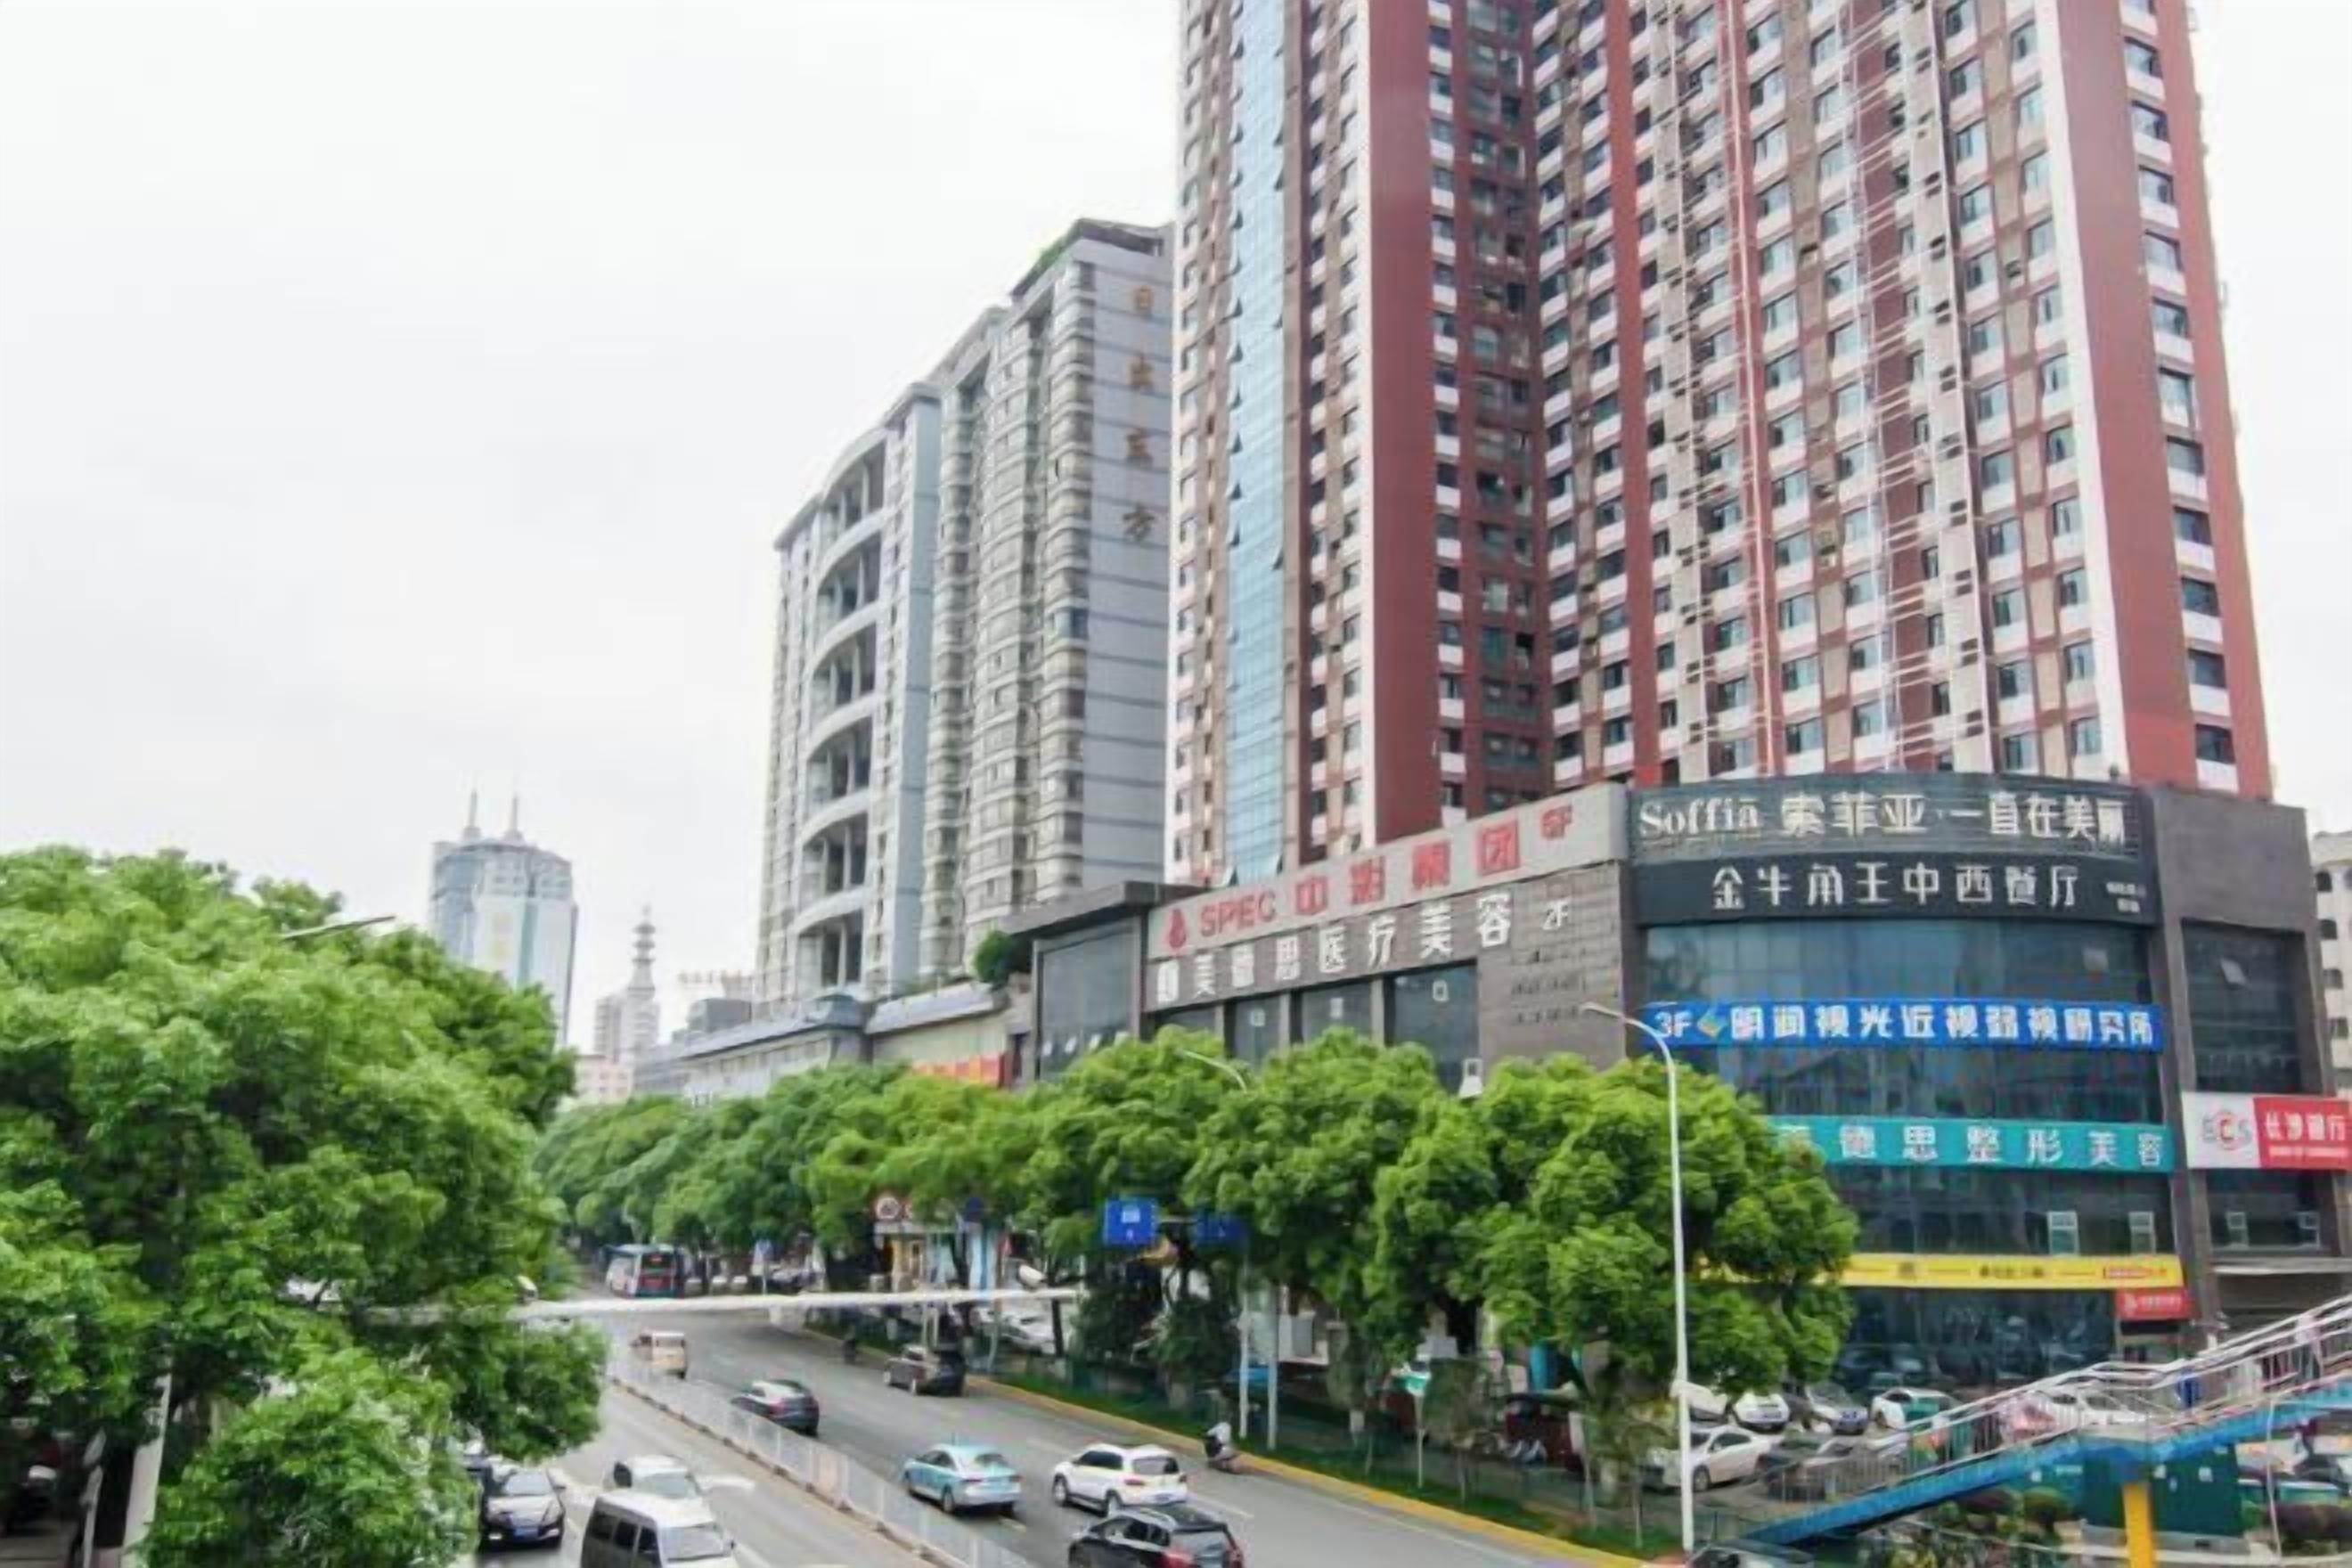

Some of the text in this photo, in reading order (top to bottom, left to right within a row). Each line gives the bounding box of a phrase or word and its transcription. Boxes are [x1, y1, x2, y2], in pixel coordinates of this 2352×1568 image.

[1711, 861, 2078, 910] 金牛角王中西餐厅
[1199, 891, 1277, 937] SPEC
[1654, 1010, 1692, 1039] 3F
